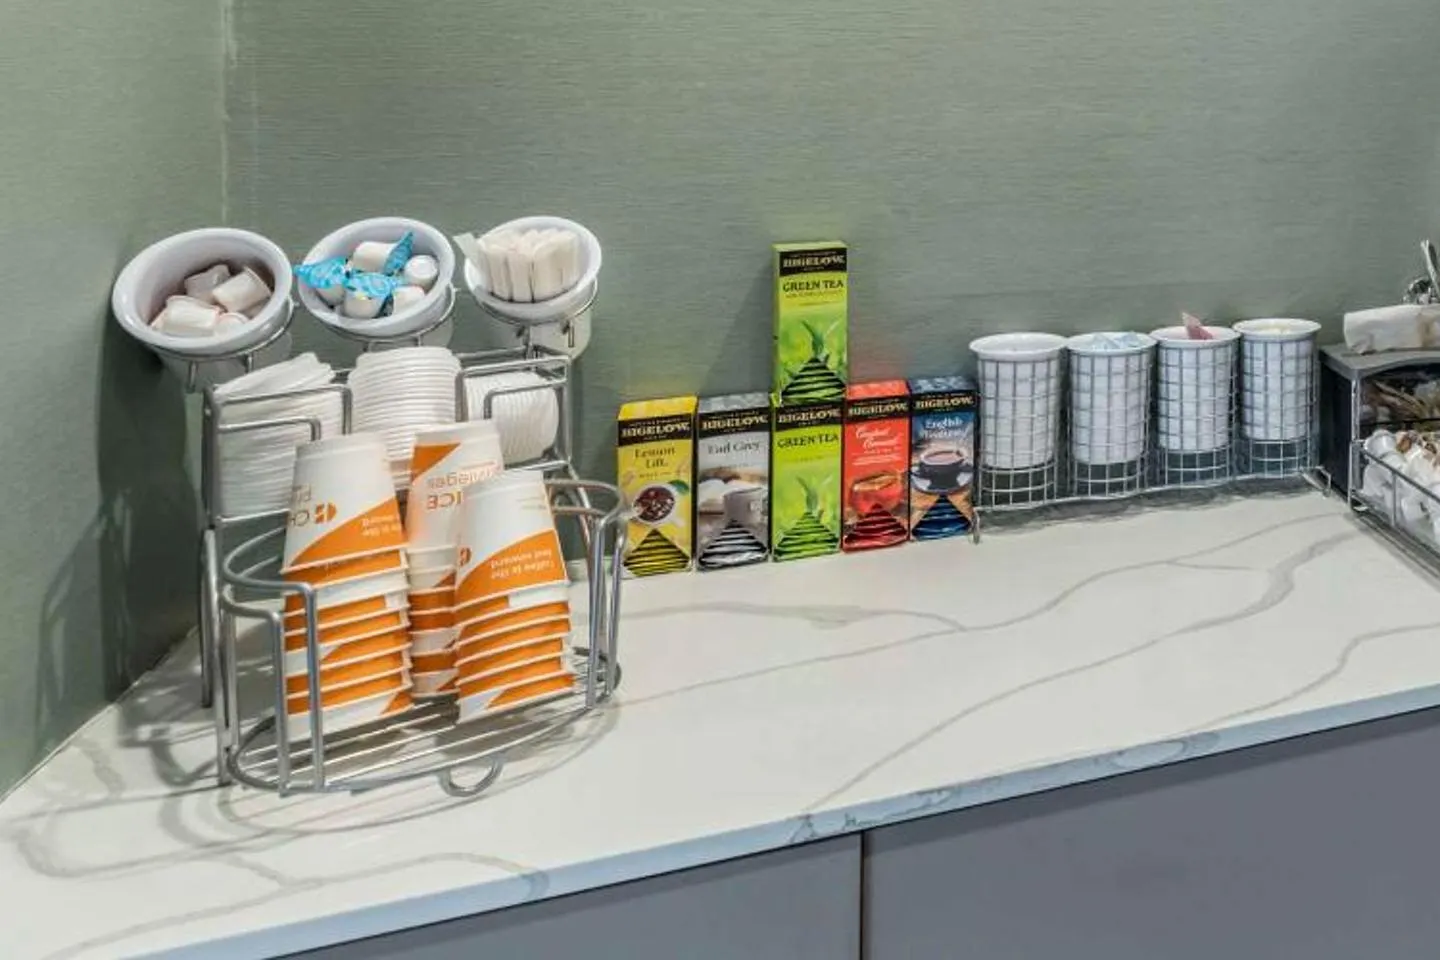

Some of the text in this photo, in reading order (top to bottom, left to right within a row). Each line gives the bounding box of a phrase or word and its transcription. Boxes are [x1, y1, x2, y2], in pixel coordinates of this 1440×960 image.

[782, 278, 845, 293] GREEN TEA
[777, 432, 840, 449] GREEN TEA
[634, 445, 676, 459] Lemon
